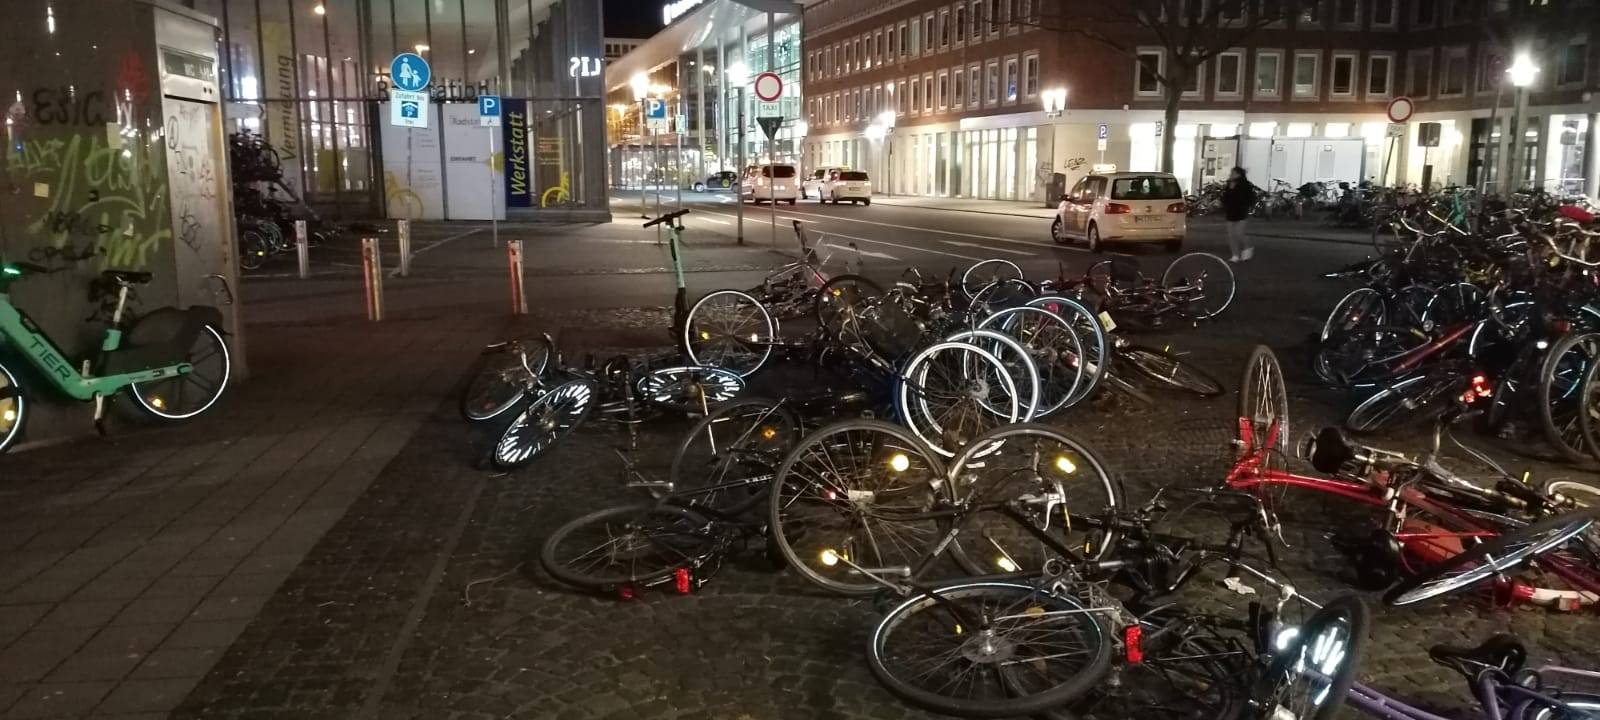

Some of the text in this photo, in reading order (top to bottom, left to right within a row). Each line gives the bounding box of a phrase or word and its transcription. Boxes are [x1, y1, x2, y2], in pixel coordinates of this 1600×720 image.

[483, 98, 495, 114] P
[650, 101, 661, 116] P
[508, 111, 526, 195] Werkstatt
[30, 336, 72, 381] TIER
